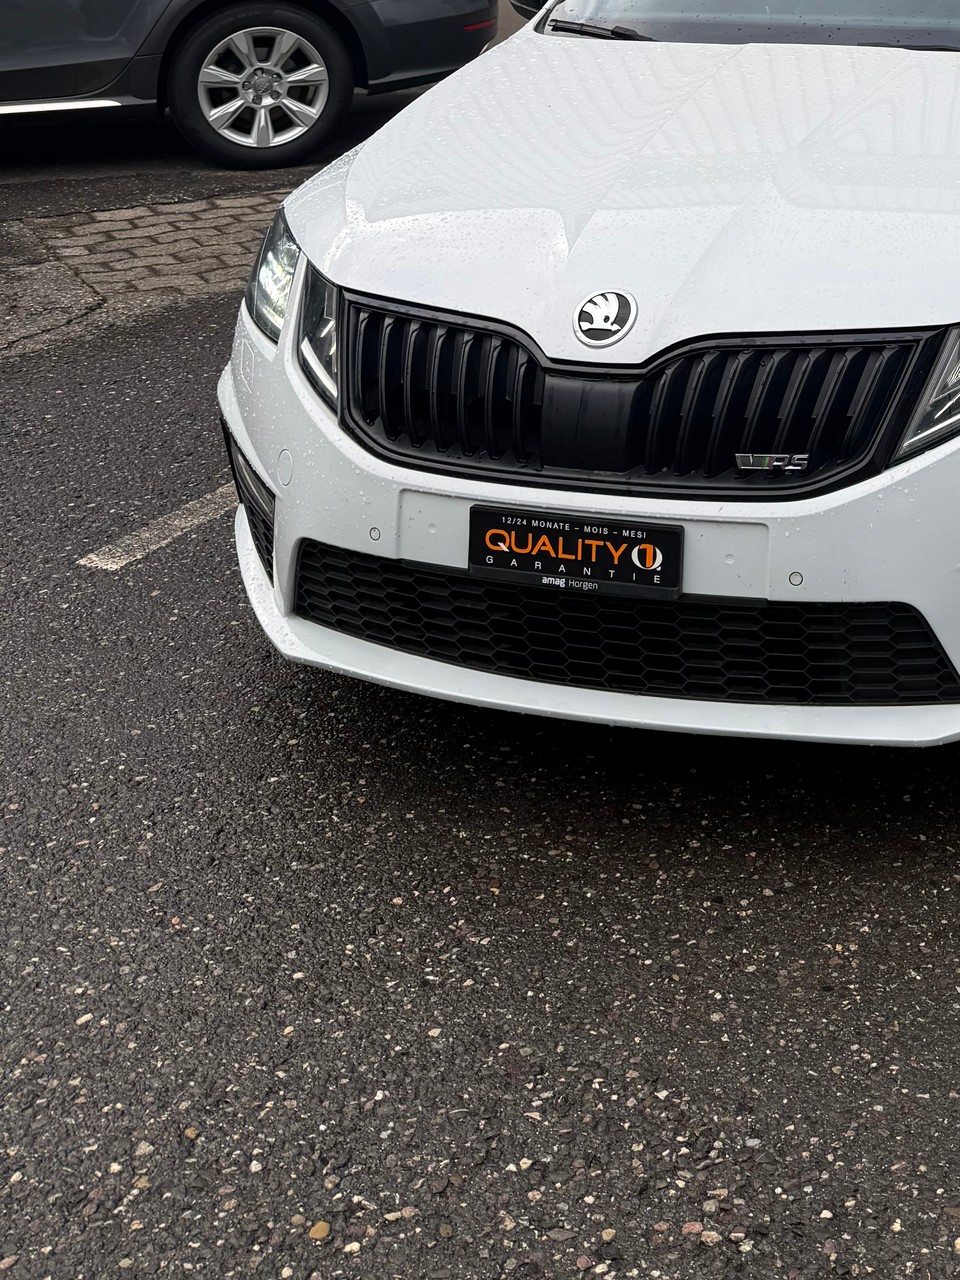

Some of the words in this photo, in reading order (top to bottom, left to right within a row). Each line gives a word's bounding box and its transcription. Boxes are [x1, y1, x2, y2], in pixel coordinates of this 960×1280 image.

[502, 516, 527, 525] 12/24
[531, 519, 570, 531] MONATE
[583, 525, 609, 535] MOIS
[622, 529, 646, 539] MESI
[485, 528, 628, 565] QUALITY
[485, 555, 661, 584] GARANTIE
[541, 576, 566, 588] amag
[568, 578, 598, 590] Horgen
